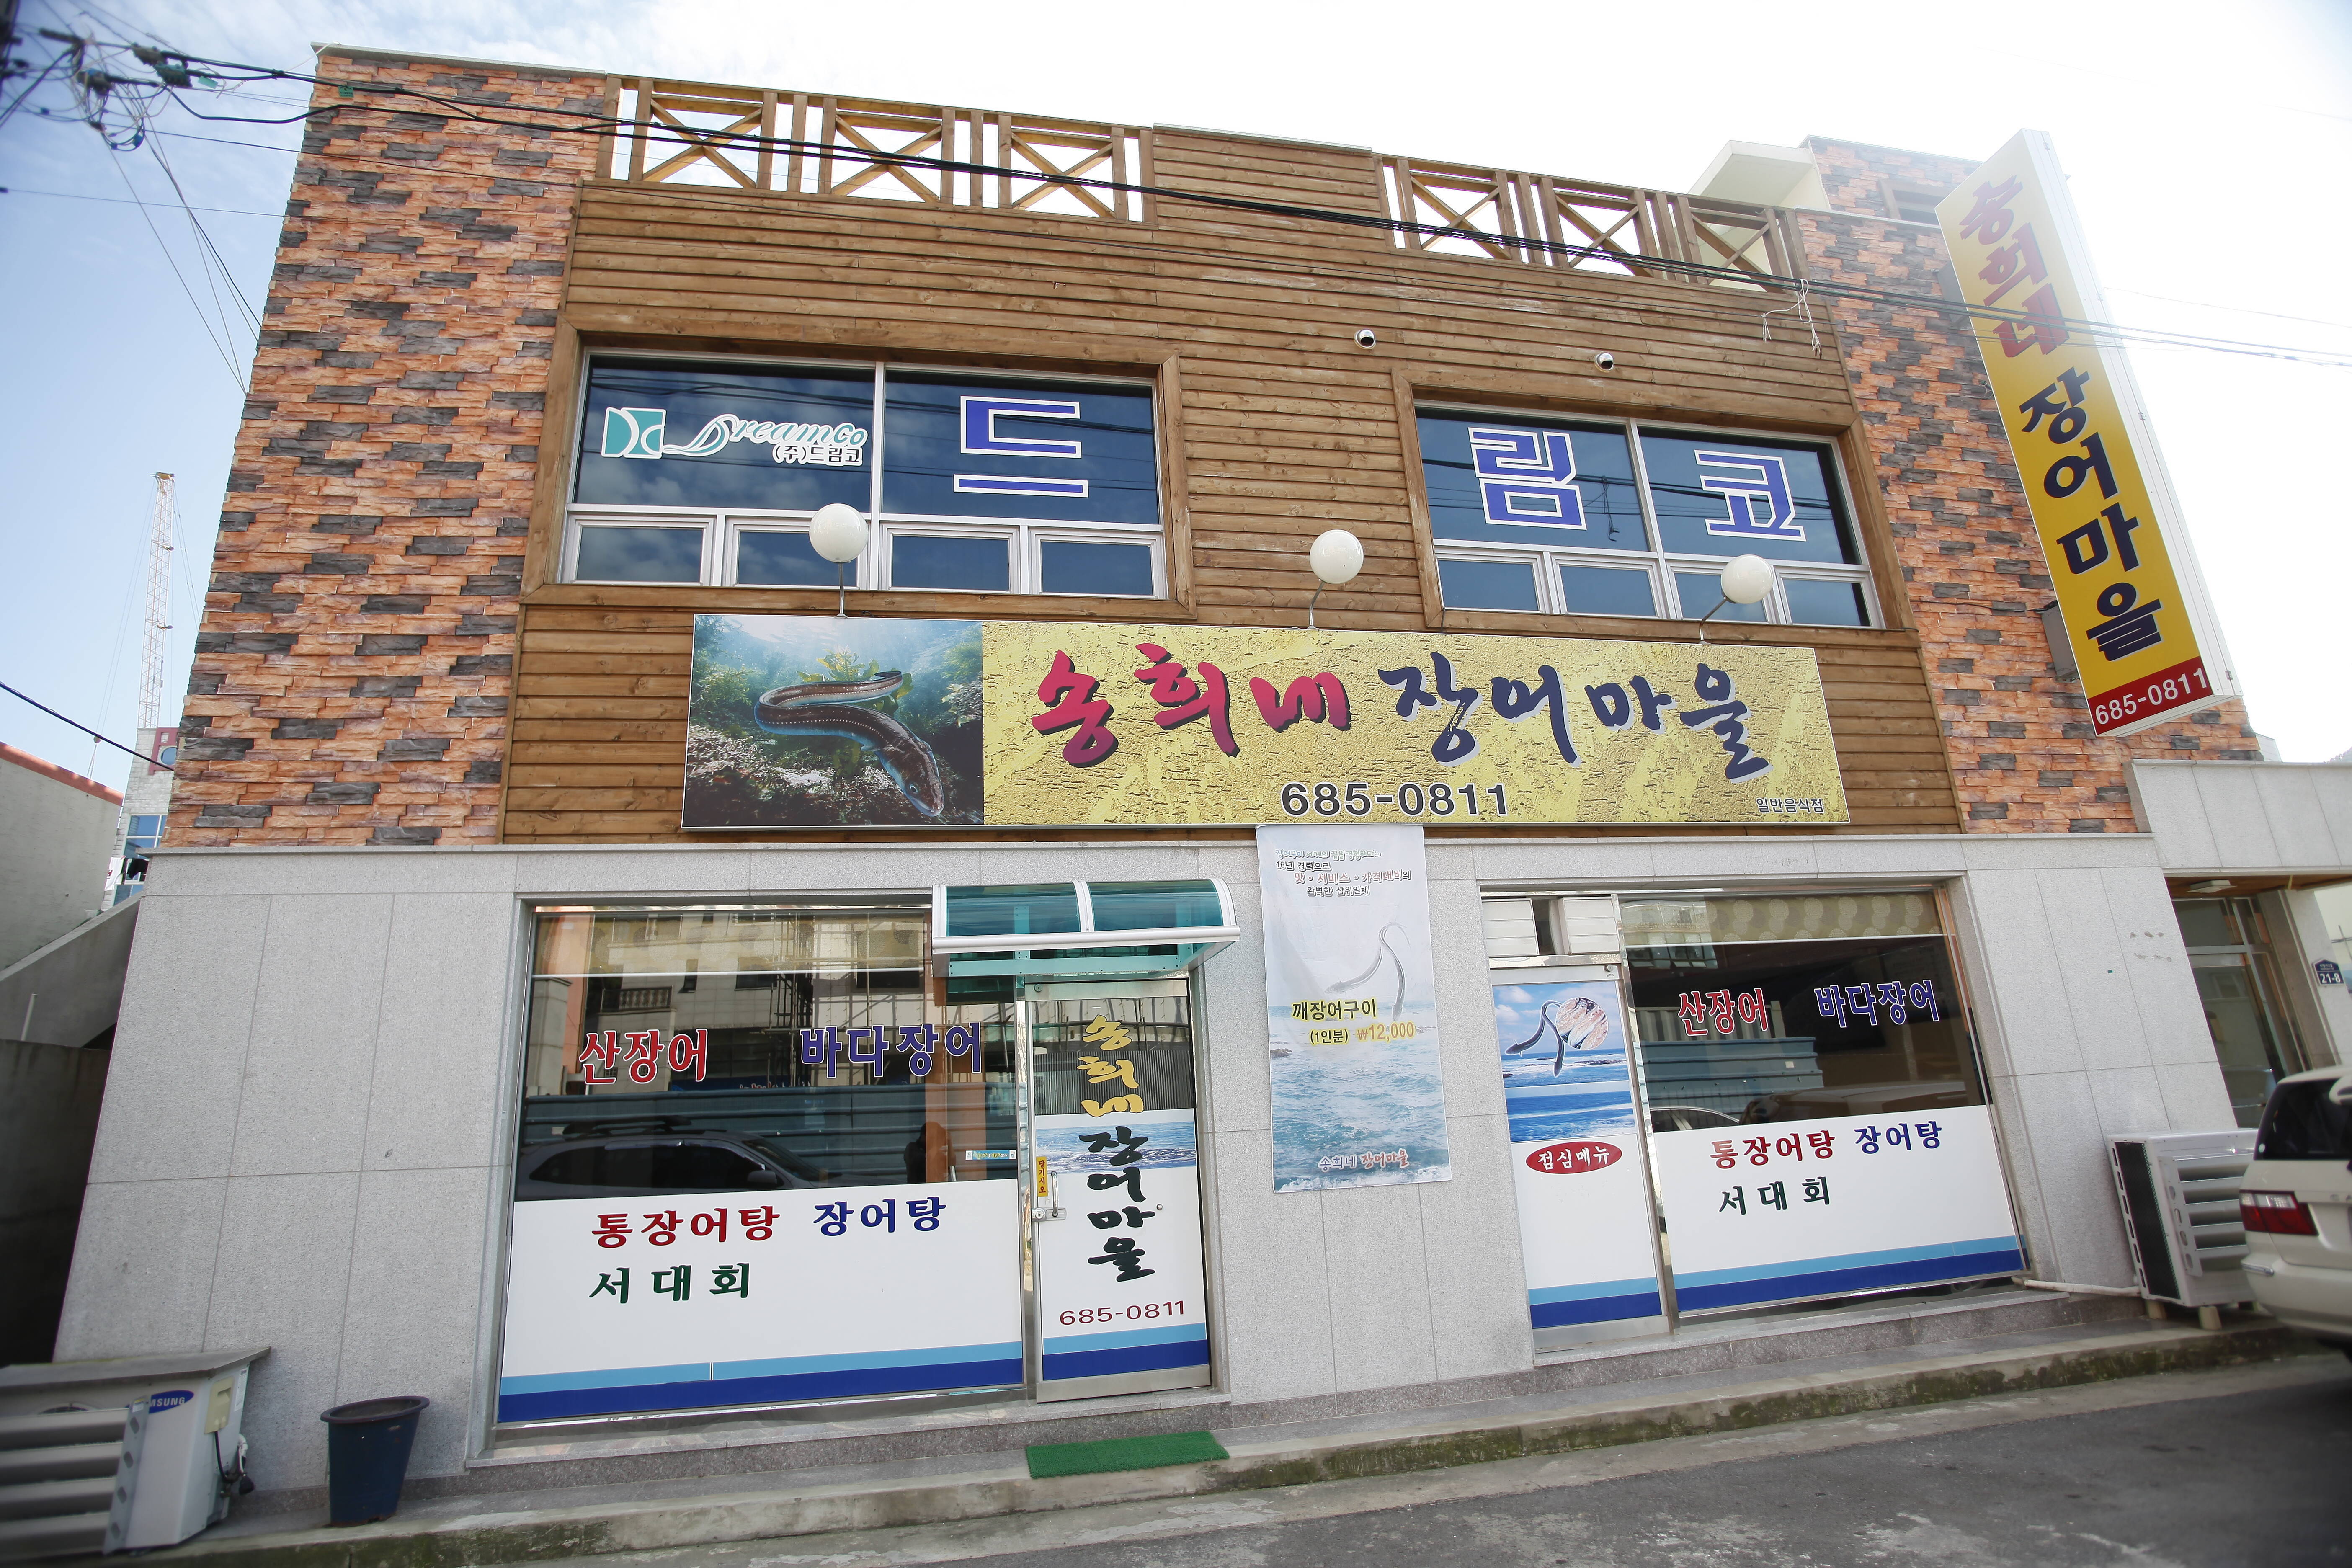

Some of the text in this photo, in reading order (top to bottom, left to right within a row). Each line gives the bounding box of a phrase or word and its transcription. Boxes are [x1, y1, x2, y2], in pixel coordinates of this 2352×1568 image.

[774, 444, 862, 465] (주)드림코
[2019, 367, 2163, 661] 장어마을
[2096, 668, 2207, 725] 685-0811
[1377, 652, 1772, 782] 장어마을
[1279, 781, 1508, 817] 685-0811
[1756, 797, 1824, 813] 일반음식점
[1275, 849, 1304, 859] 장어구이
[1276, 861, 1331, 871] 16년 경력으로
[1295, 872, 1305, 884] 맛
[1317, 872, 1350, 885] 서비스
[1307, 885, 1370, 896] 완벽한 삼위일체
[2320, 973, 2341, 983] 21-8
[1293, 998, 1377, 1020] 깨장어구이
[1677, 979, 1940, 1037] 산장어 바다장어
[1310, 1022, 1414, 1044] (1인분) ₩12,000
[579, 1021, 982, 1085] 산장어 바다장어
[1710, 1120, 1943, 1169] 통장어탕 장어탕
[1319, 1149, 1409, 1171] 송희네 장어마을
[1538, 1146, 1610, 1170] 점심메뉴
[1079, 1126, 1155, 1282] 장어마을
[592, 1197, 947, 1248] 통장어탕 장어탕
[1060, 1300, 1185, 1326] 685-0811
